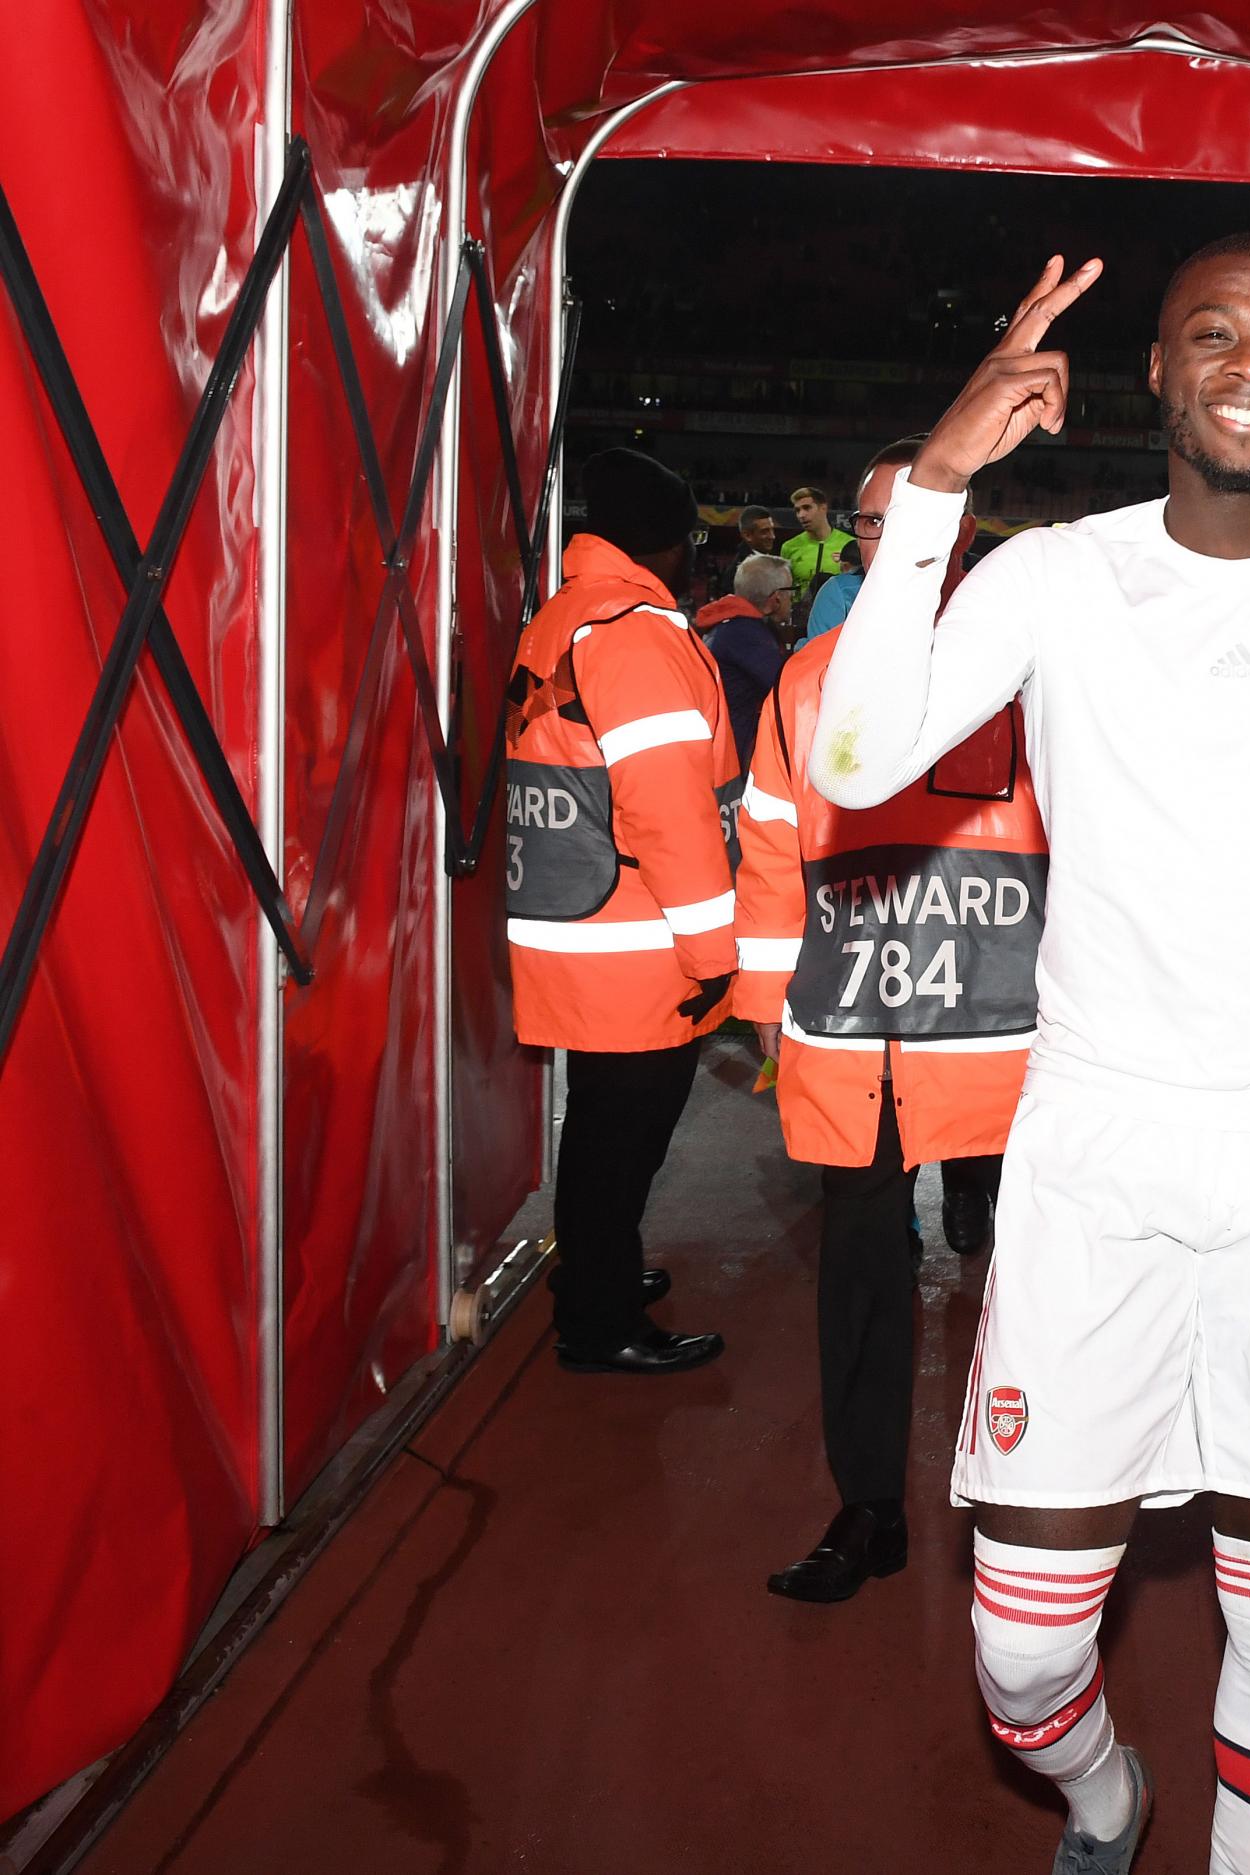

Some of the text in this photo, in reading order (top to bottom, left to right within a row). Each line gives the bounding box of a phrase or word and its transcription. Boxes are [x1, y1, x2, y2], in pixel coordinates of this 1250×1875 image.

[1091, 431, 1144, 447] Arsenal
[507, 784, 578, 830] ARD
[507, 835, 524, 891] 3
[816, 875, 1030, 933] STEWARD
[837, 939, 963, 1009] 784
[992, 1397, 1023, 1408] Arsenal
